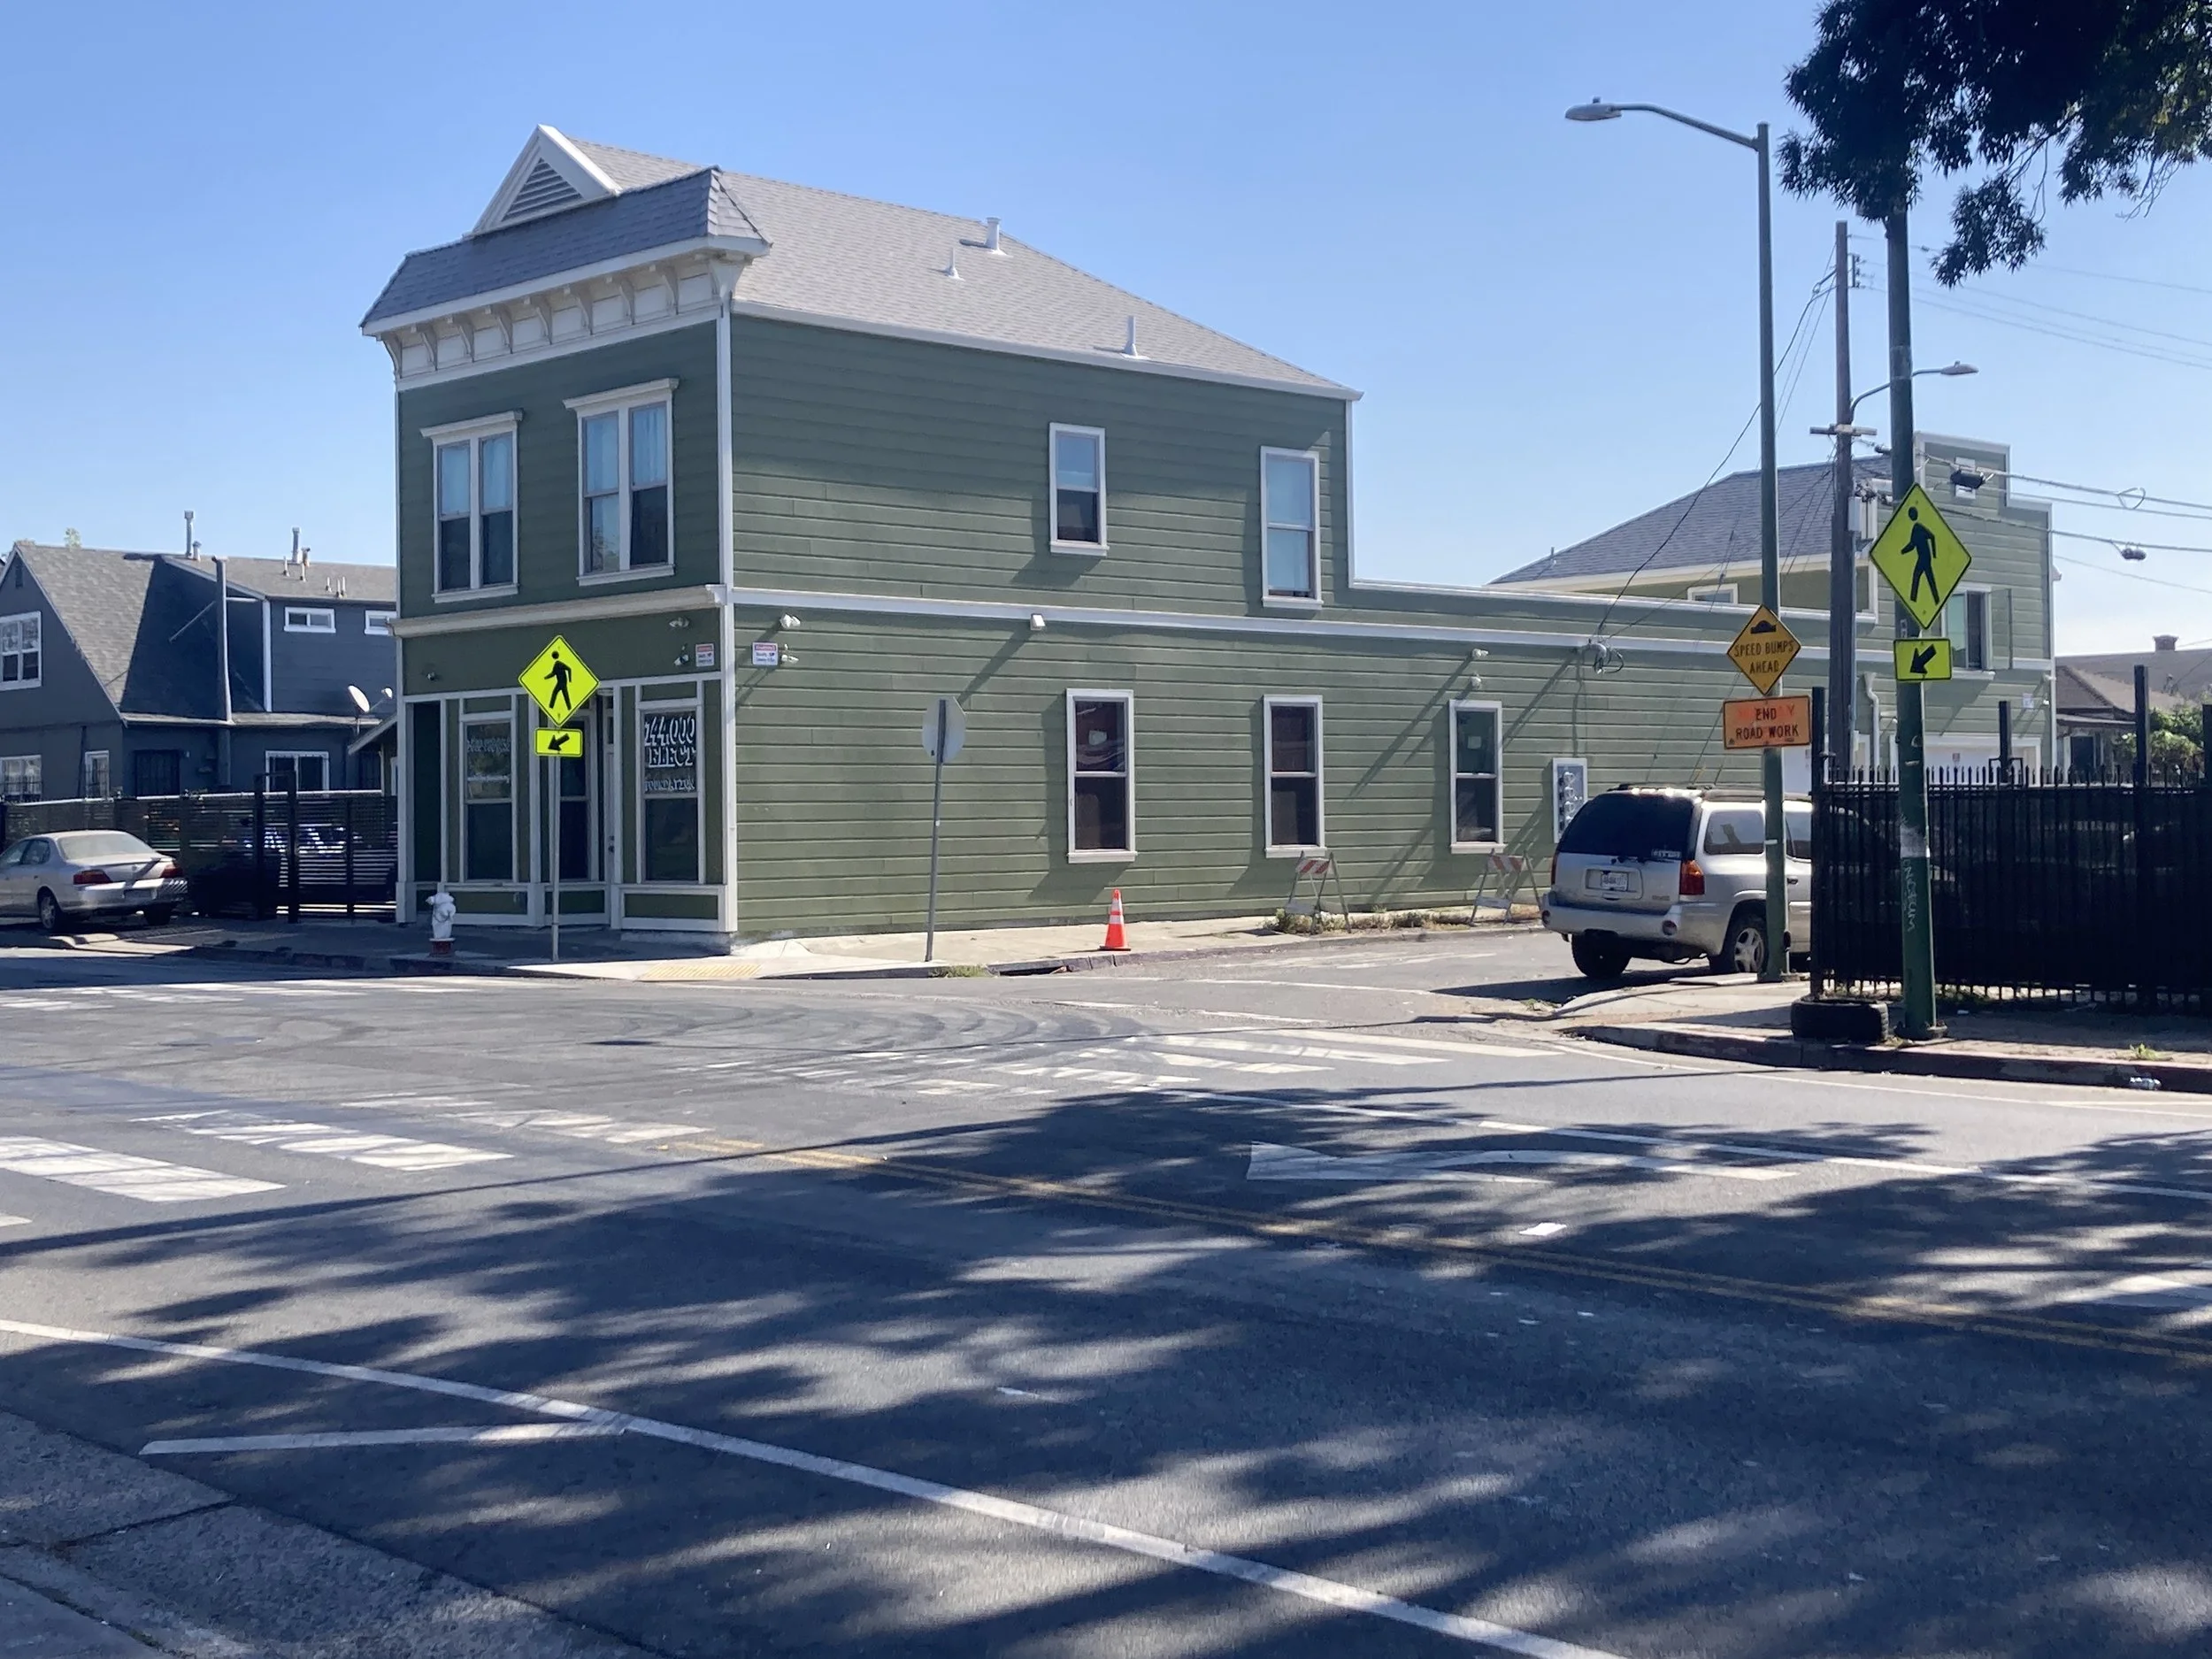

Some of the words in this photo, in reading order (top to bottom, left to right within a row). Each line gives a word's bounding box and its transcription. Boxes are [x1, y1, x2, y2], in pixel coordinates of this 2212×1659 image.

[1734, 642, 1761, 657] SPEED
[1765, 640, 1794, 655] BUMPS
[1750, 660, 1779, 674] AHEAD
[1755, 707, 1777, 721] END
[1735, 726, 1763, 740] ROAD
[1769, 724, 1800, 738] WORK
